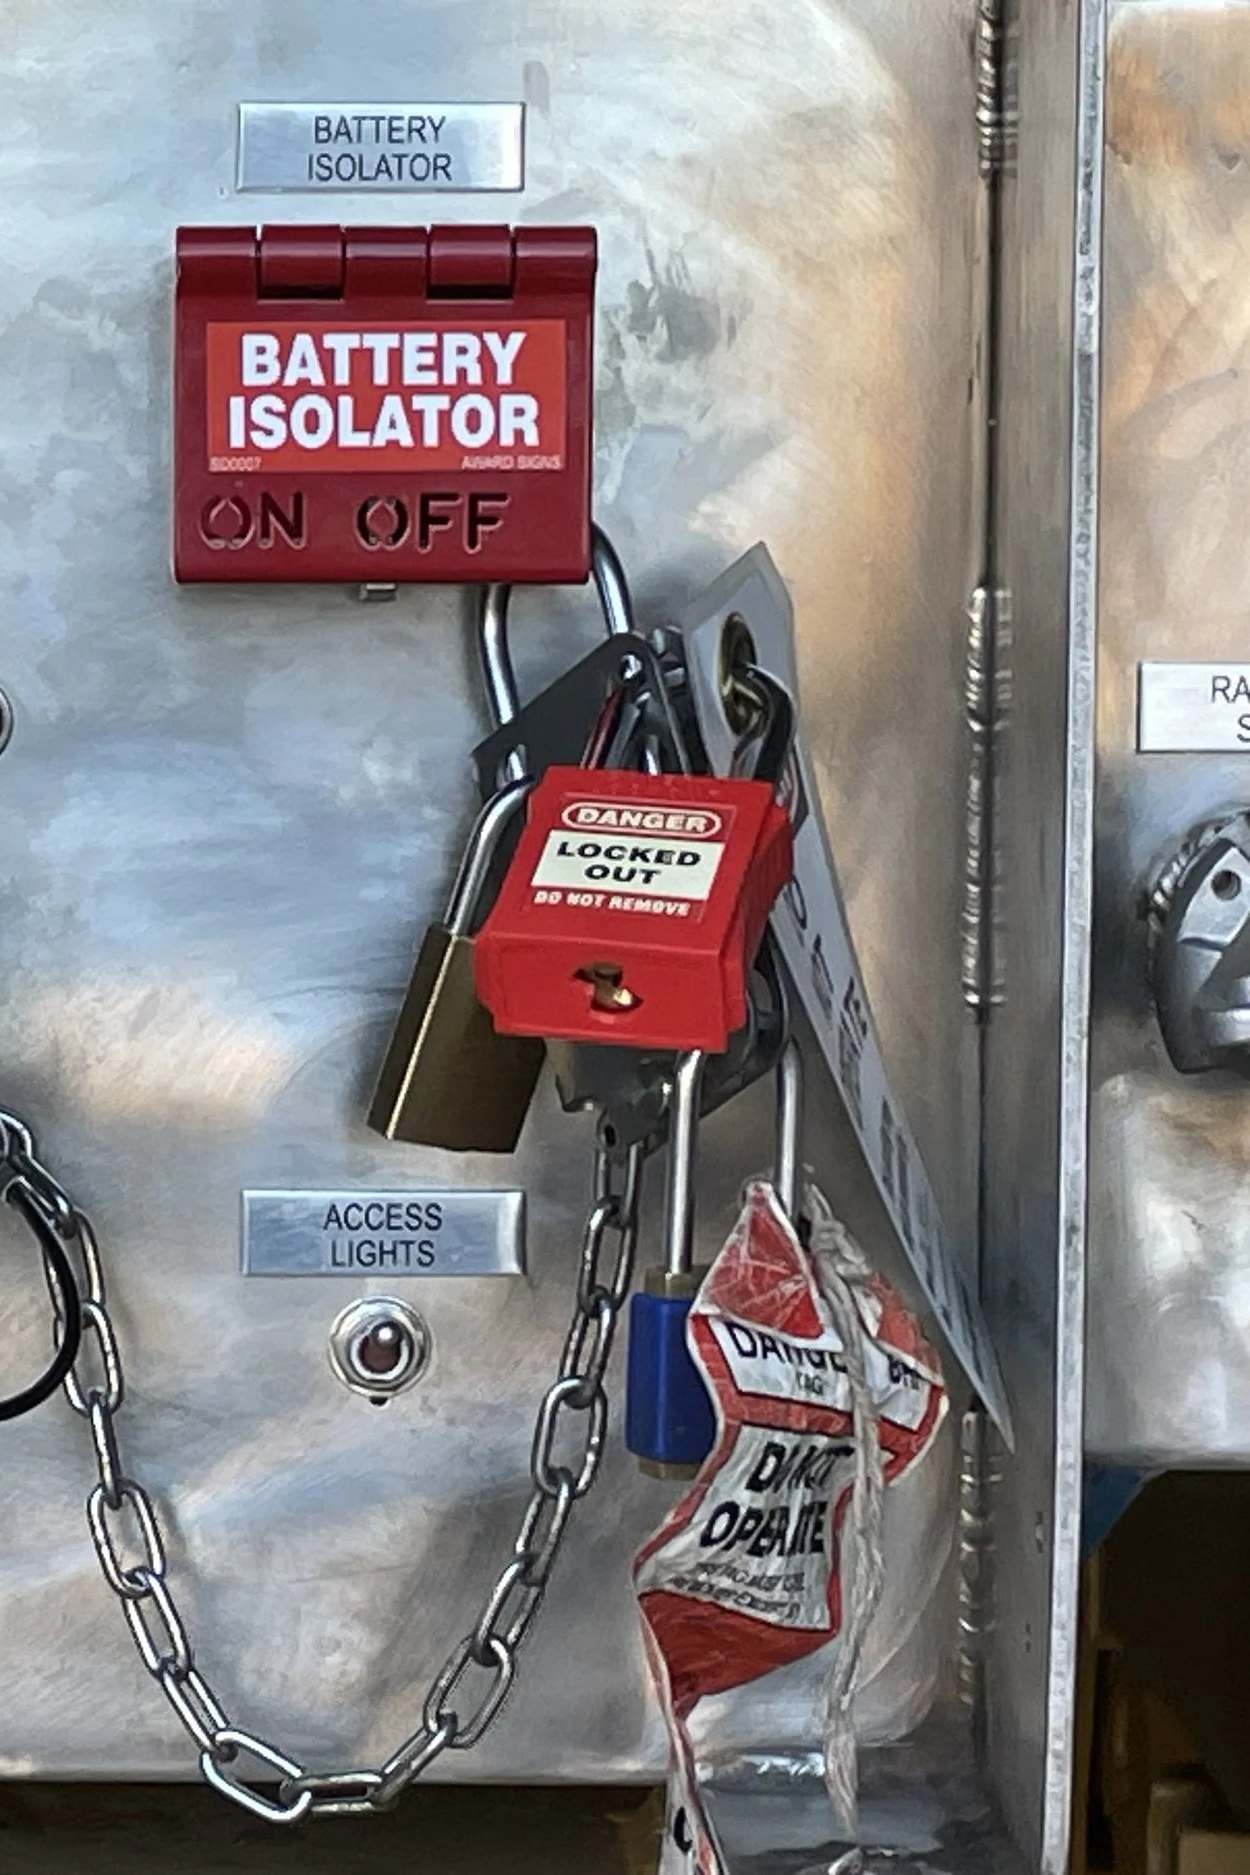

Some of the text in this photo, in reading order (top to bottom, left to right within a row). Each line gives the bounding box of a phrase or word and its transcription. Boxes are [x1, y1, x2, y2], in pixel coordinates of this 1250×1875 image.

[314, 115, 447, 144] BATTERY
[308, 153, 452, 182] ISOLATOR
[241, 331, 527, 387] BATTERY
[228, 394, 540, 450] ISOLATOR
[199, 491, 512, 555] ON OFF
[577, 807, 707, 833] DANGER
[557, 841, 701, 866] LOCKED
[584, 865, 662, 885] OUT
[534, 891, 691, 917] DO NOT REMOVE
[323, 1202, 443, 1231] ACCESS
[331, 1240, 436, 1268] LIGHTS
